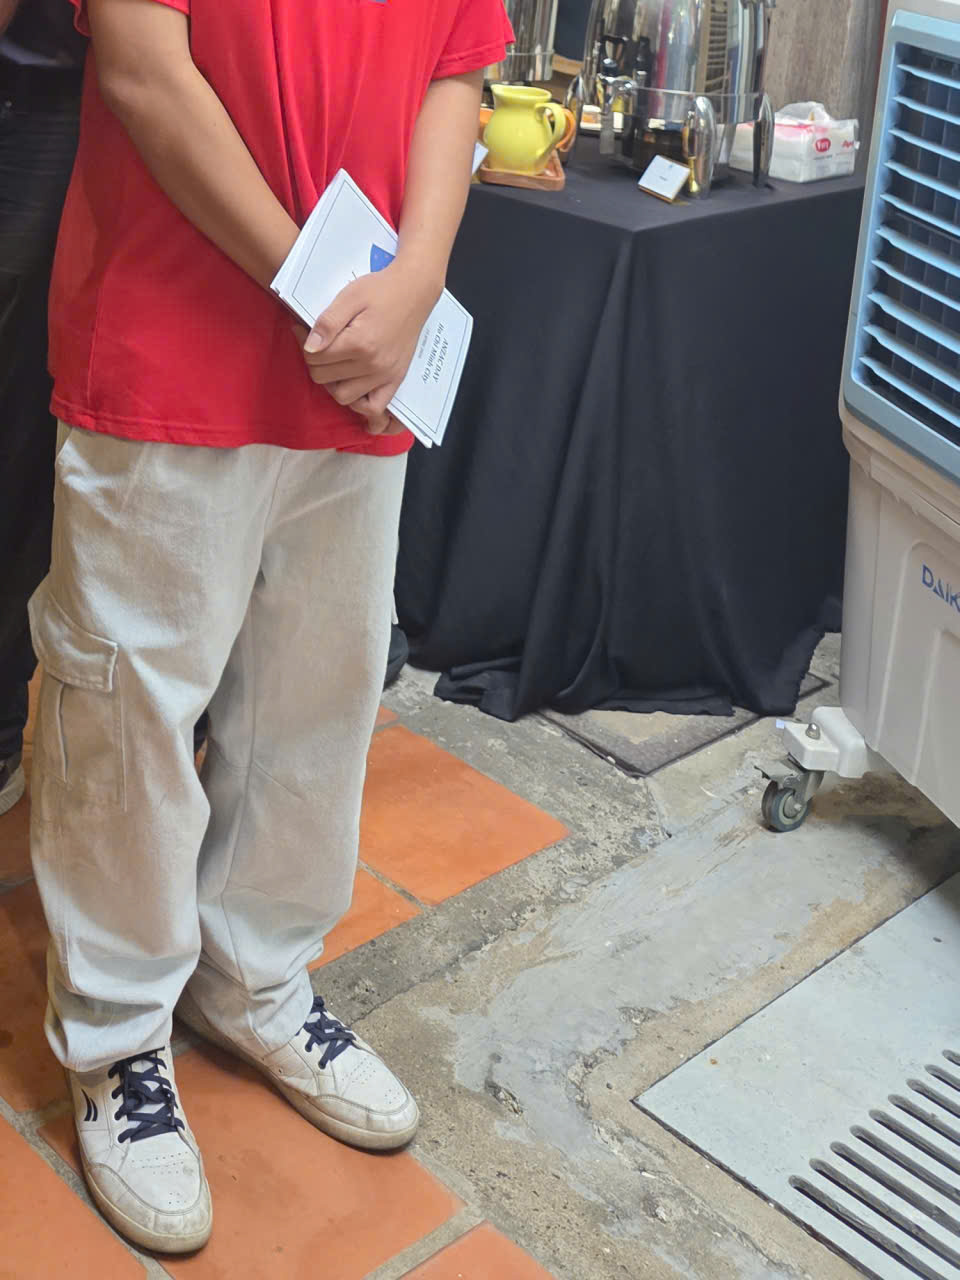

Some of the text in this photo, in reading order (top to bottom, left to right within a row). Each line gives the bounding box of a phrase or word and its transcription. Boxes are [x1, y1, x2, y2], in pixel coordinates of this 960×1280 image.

[426, 347, 438, 368] Minh
[432, 337, 449, 383] ANZAC DAY
[422, 367, 431, 384] City
